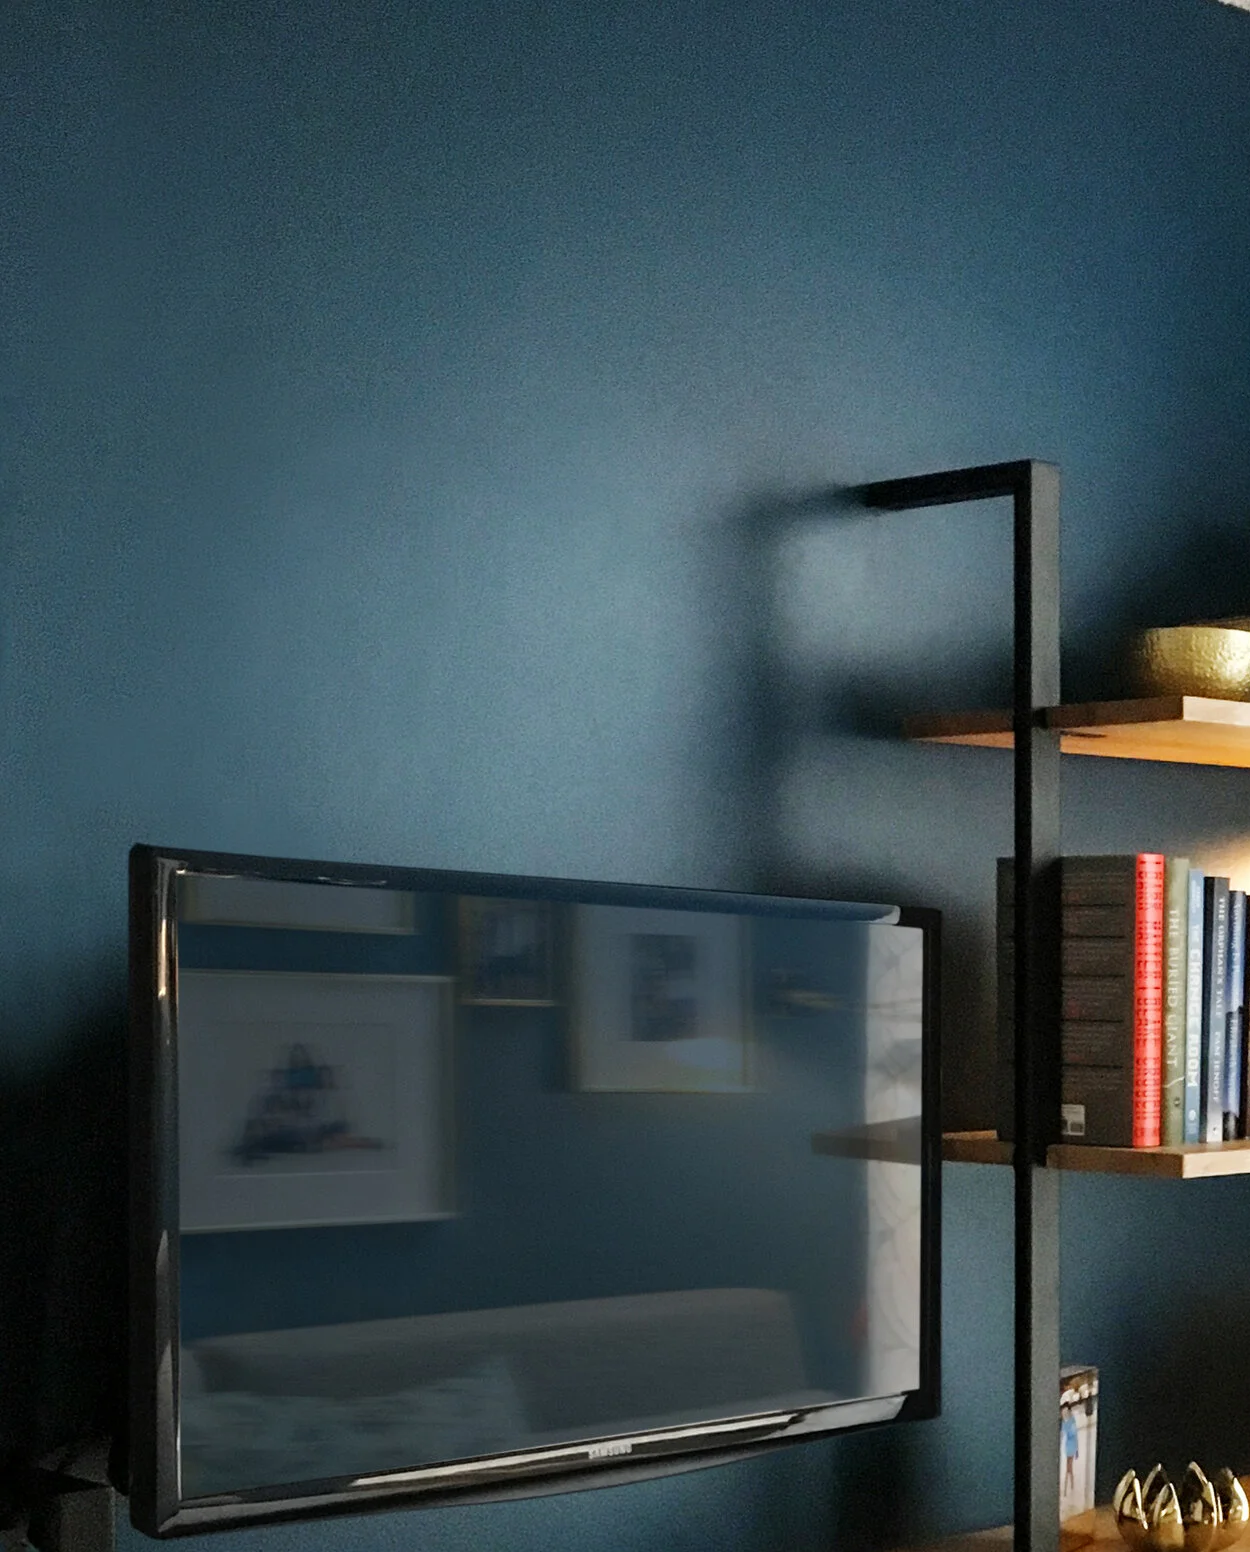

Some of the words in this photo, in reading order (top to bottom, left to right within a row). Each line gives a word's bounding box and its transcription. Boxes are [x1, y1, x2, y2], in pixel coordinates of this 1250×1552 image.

[1168, 908, 1180, 938] THE
[1218, 896, 1226, 921] THE
[1215, 925, 1225, 985] ORPHAN'S
[1167, 947, 1179, 1008] BURIED
[1215, 989, 1223, 1017] TALE
[1165, 1014, 1177, 1068] GIANT
[1186, 1033, 1201, 1088] ROOM
[1213, 1031, 1221, 1056] PAM
